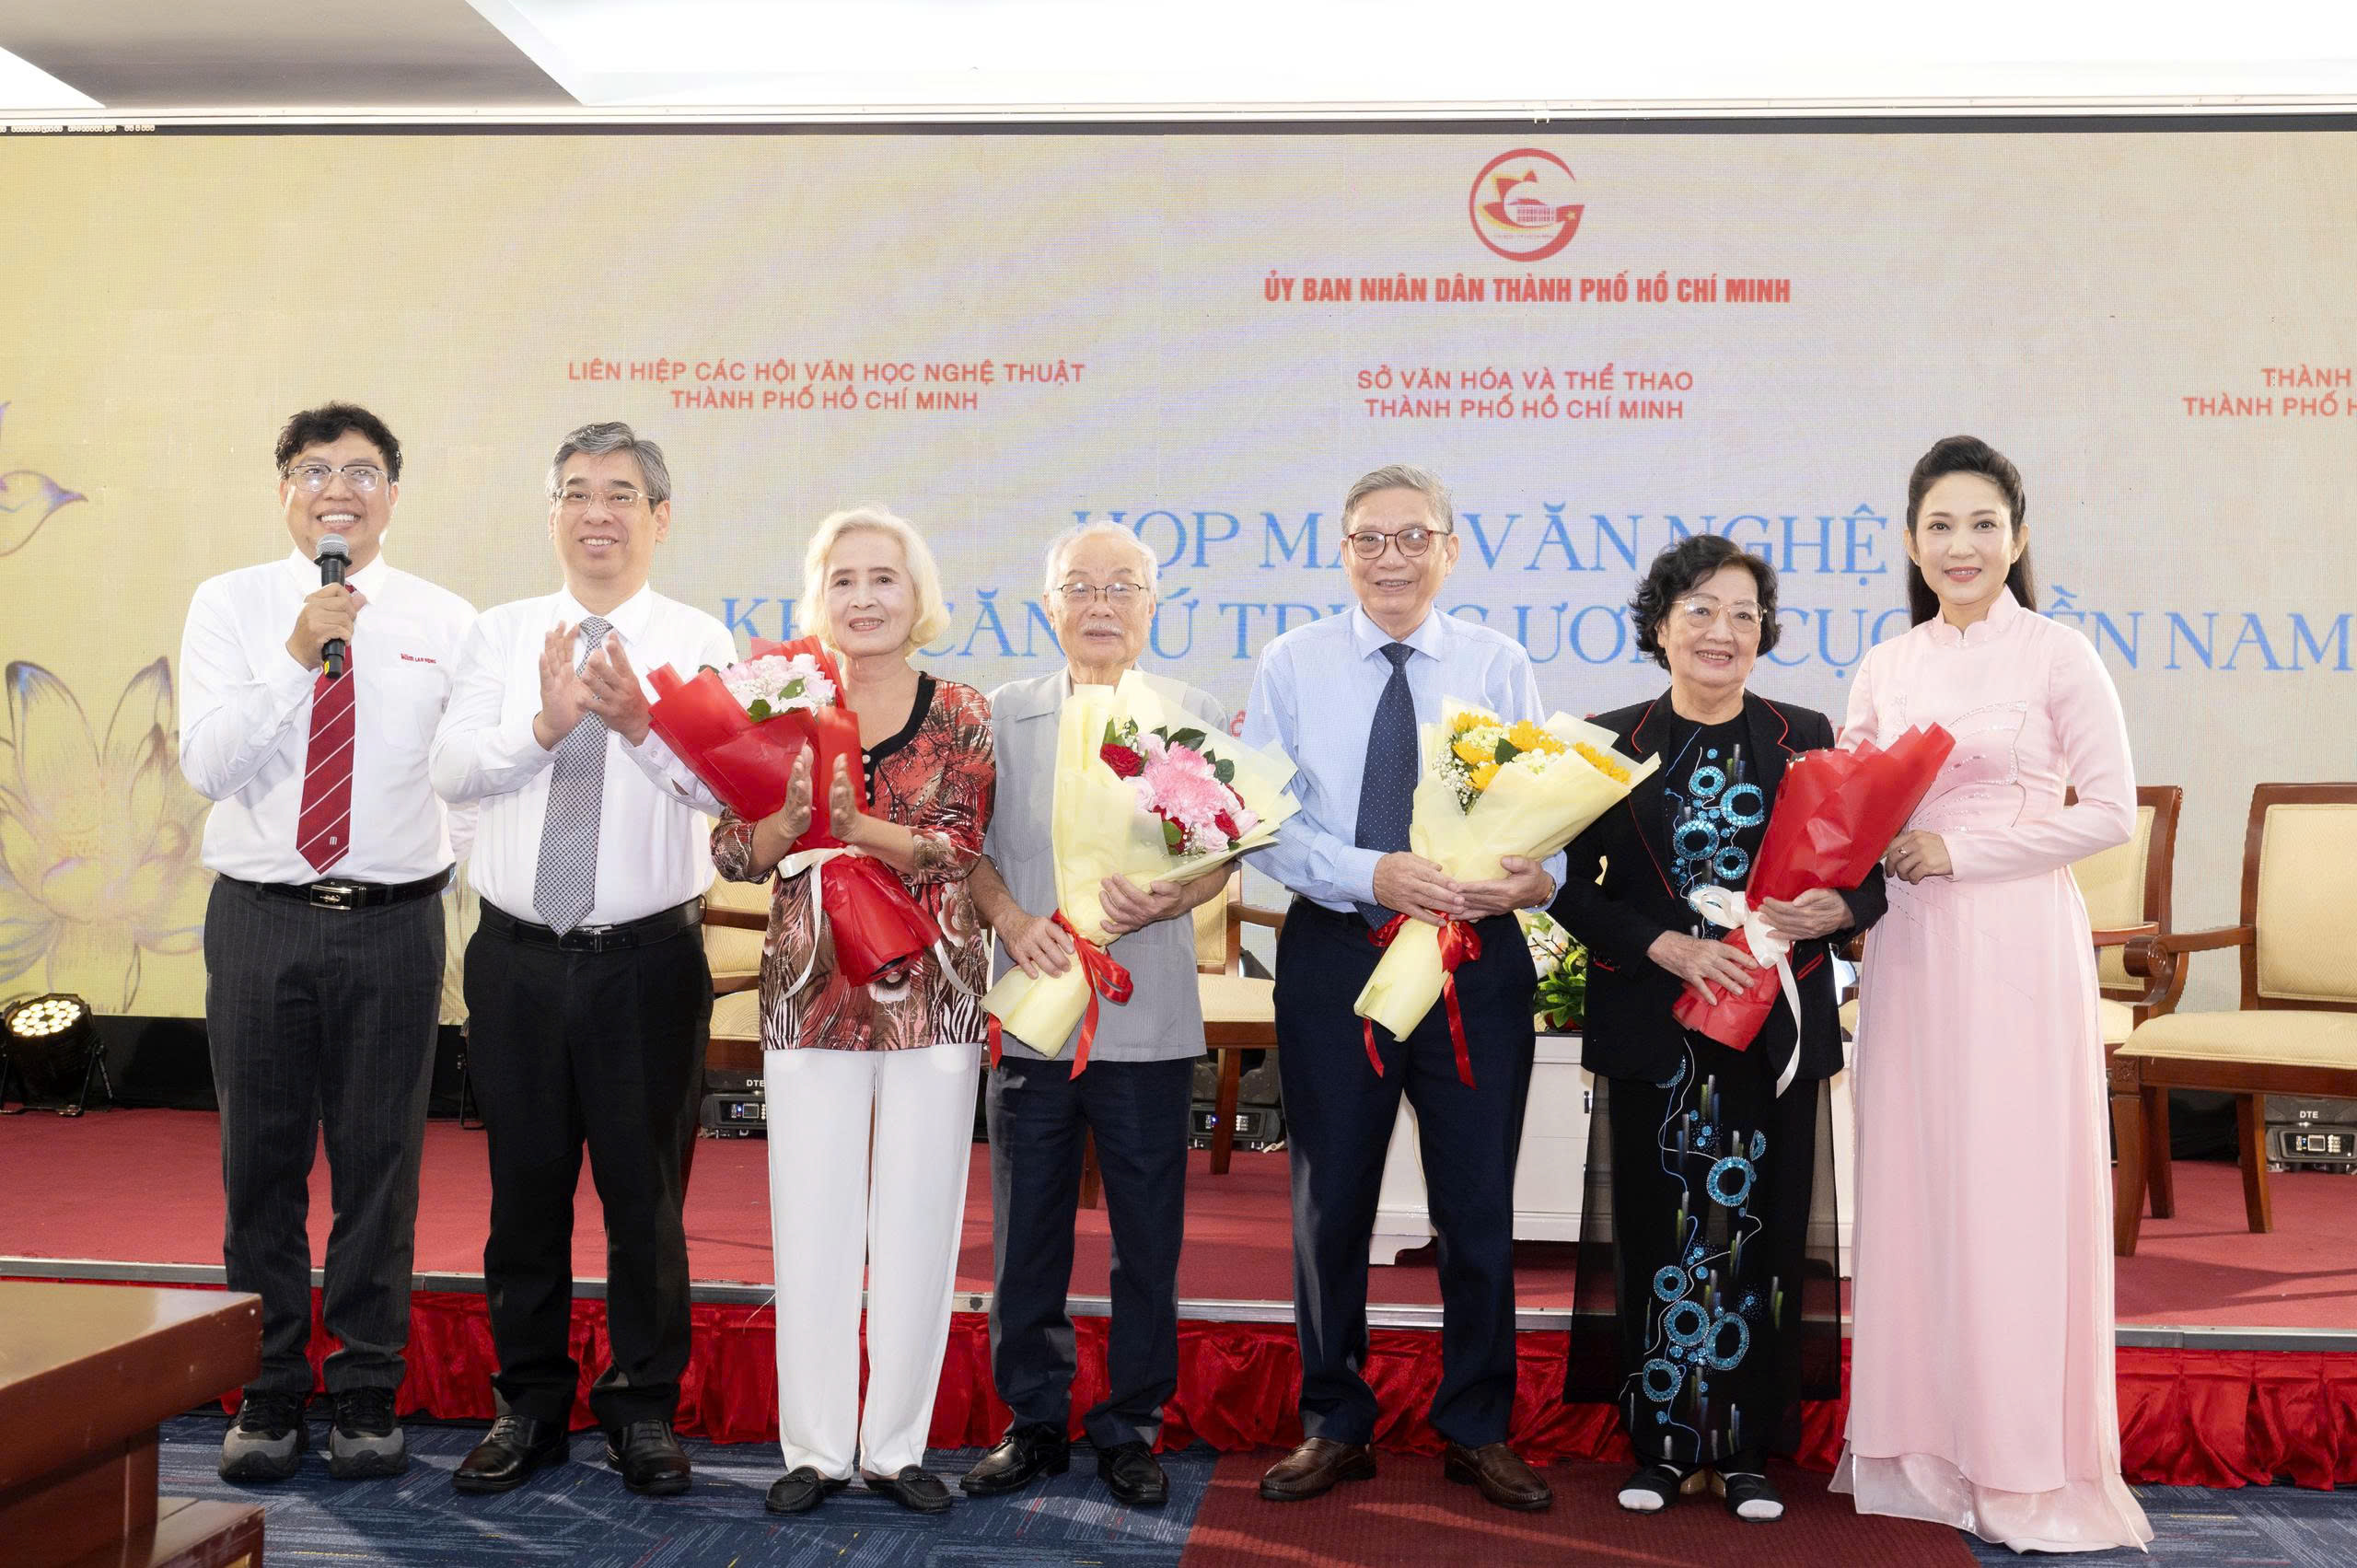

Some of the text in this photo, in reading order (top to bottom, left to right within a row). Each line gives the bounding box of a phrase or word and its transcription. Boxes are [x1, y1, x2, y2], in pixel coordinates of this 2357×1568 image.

[1264, 270, 1792, 304] ỦY BAN NHÂN DÂN THÀNH PHỐ HỒ CHÍ MINH
[568, 357, 1085, 386] LIÊN HIỆP CÁC HỘI VĂN HỌC NGHỆ THUẬT
[1357, 363, 1694, 392] SỞ VĂN HÓA VÀ THỂ THAO
[2261, 365, 2352, 388] THÀNH
[671, 385, 979, 411] THÀNH PHỐ HỒ CHÍ MINH
[1364, 390, 1684, 420] THÀNH PHỐ HỒ CHÍ MINH
[2182, 392, 2272, 416] THÀNH
[2282, 389, 2339, 417] PHỐ
[1462, 500, 1644, 572] VĂN
[2164, 610, 2354, 671] NAM
[746, 1079, 765, 1087] DTE
[2299, 1109, 2319, 1119] DTE
